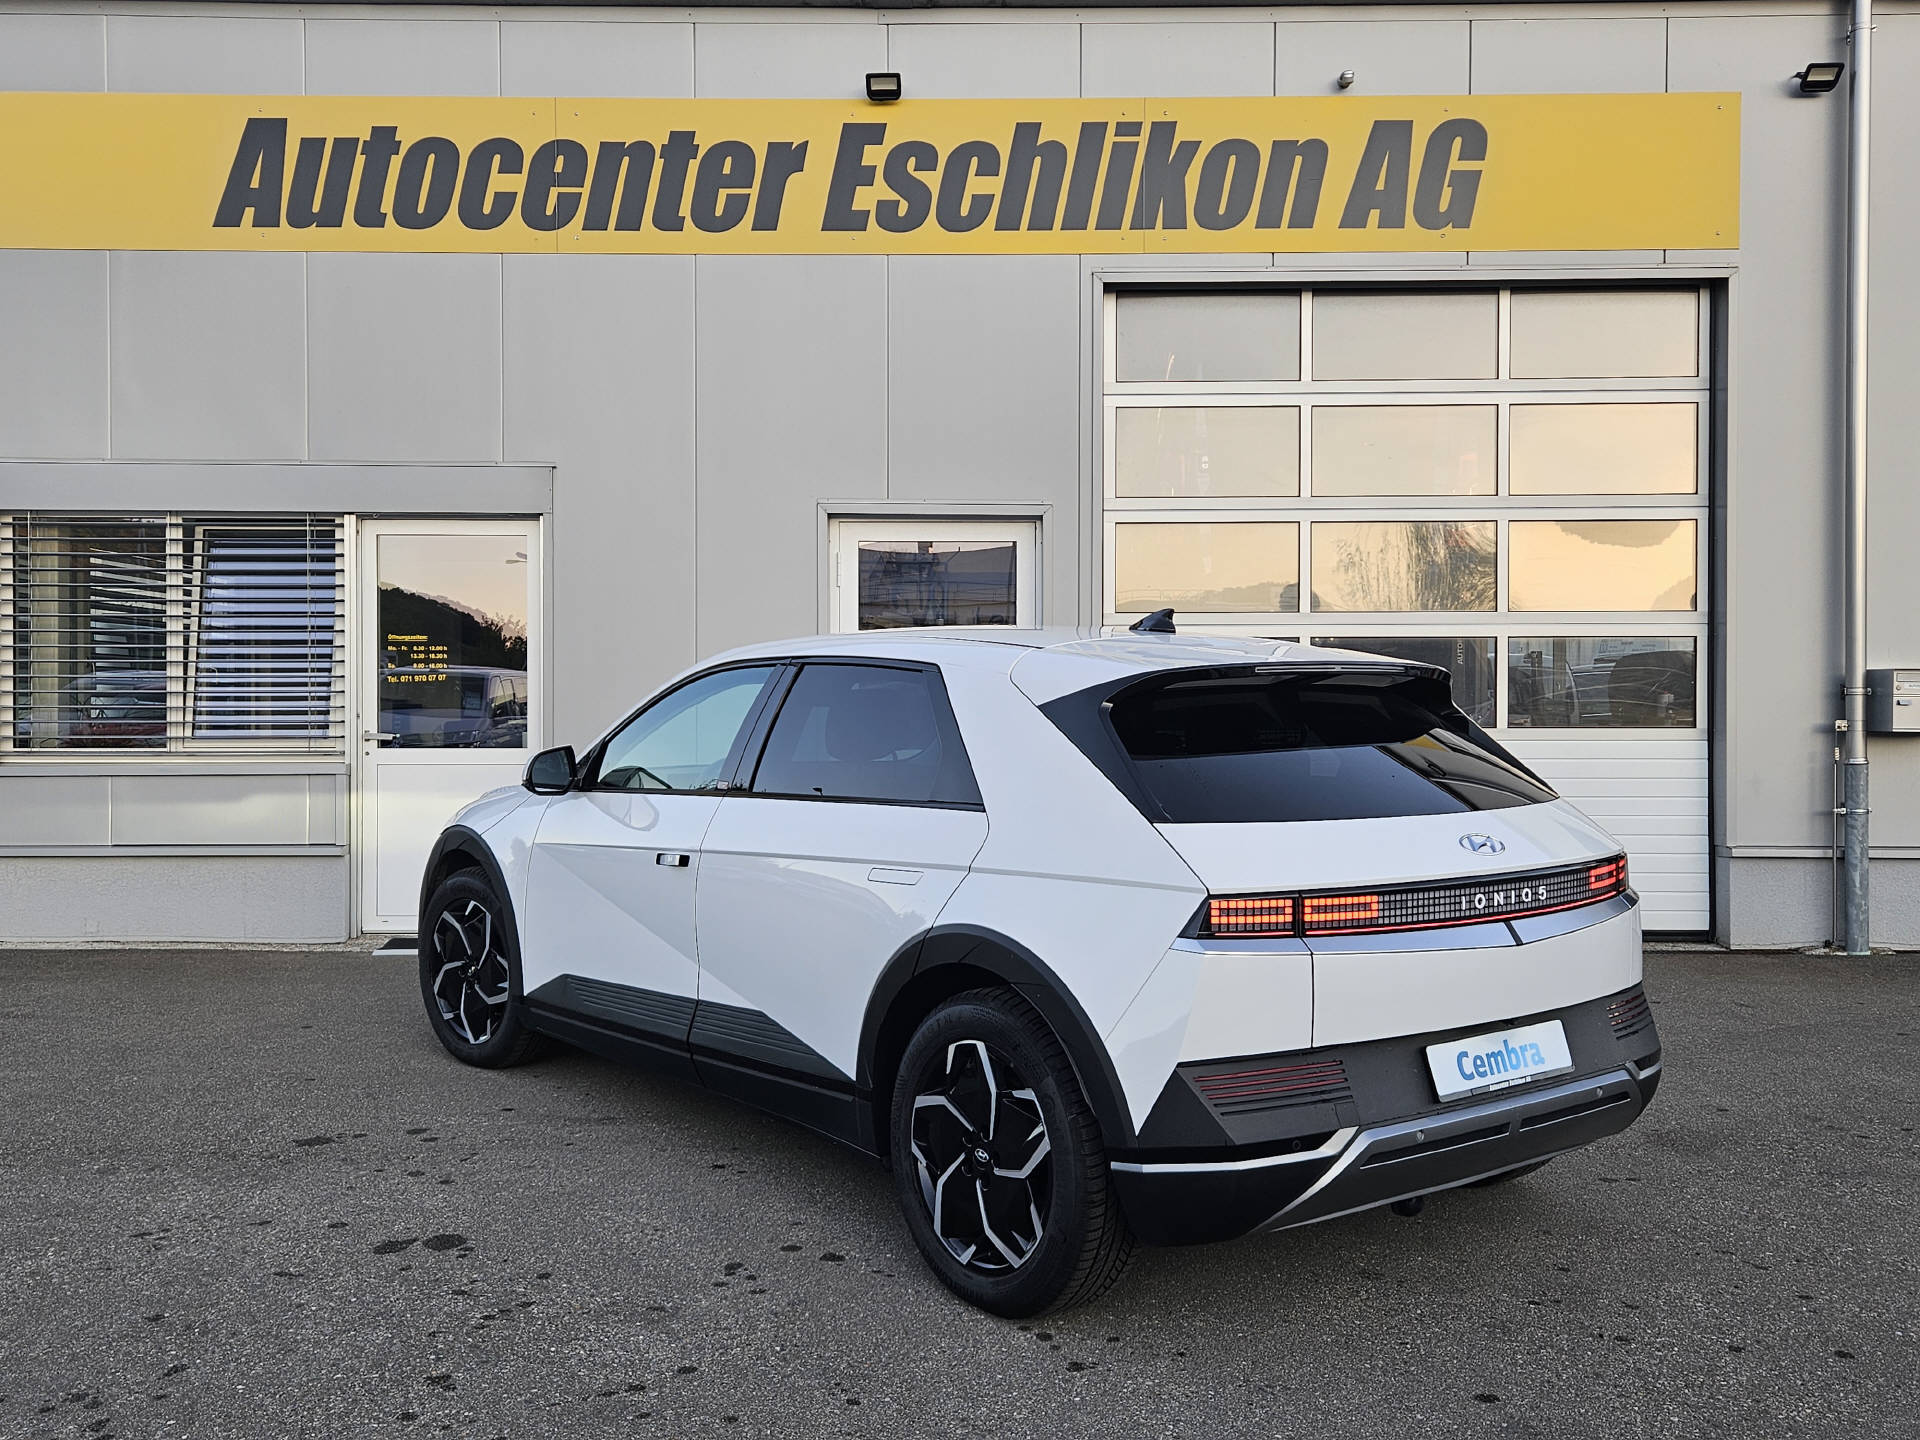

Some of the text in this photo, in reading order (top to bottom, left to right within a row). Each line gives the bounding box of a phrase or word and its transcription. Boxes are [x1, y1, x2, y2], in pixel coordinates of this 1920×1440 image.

[212, 117, 1488, 233] Autocenter Eschlikon AG
[1457, 1039, 1545, 1081] Cembra
